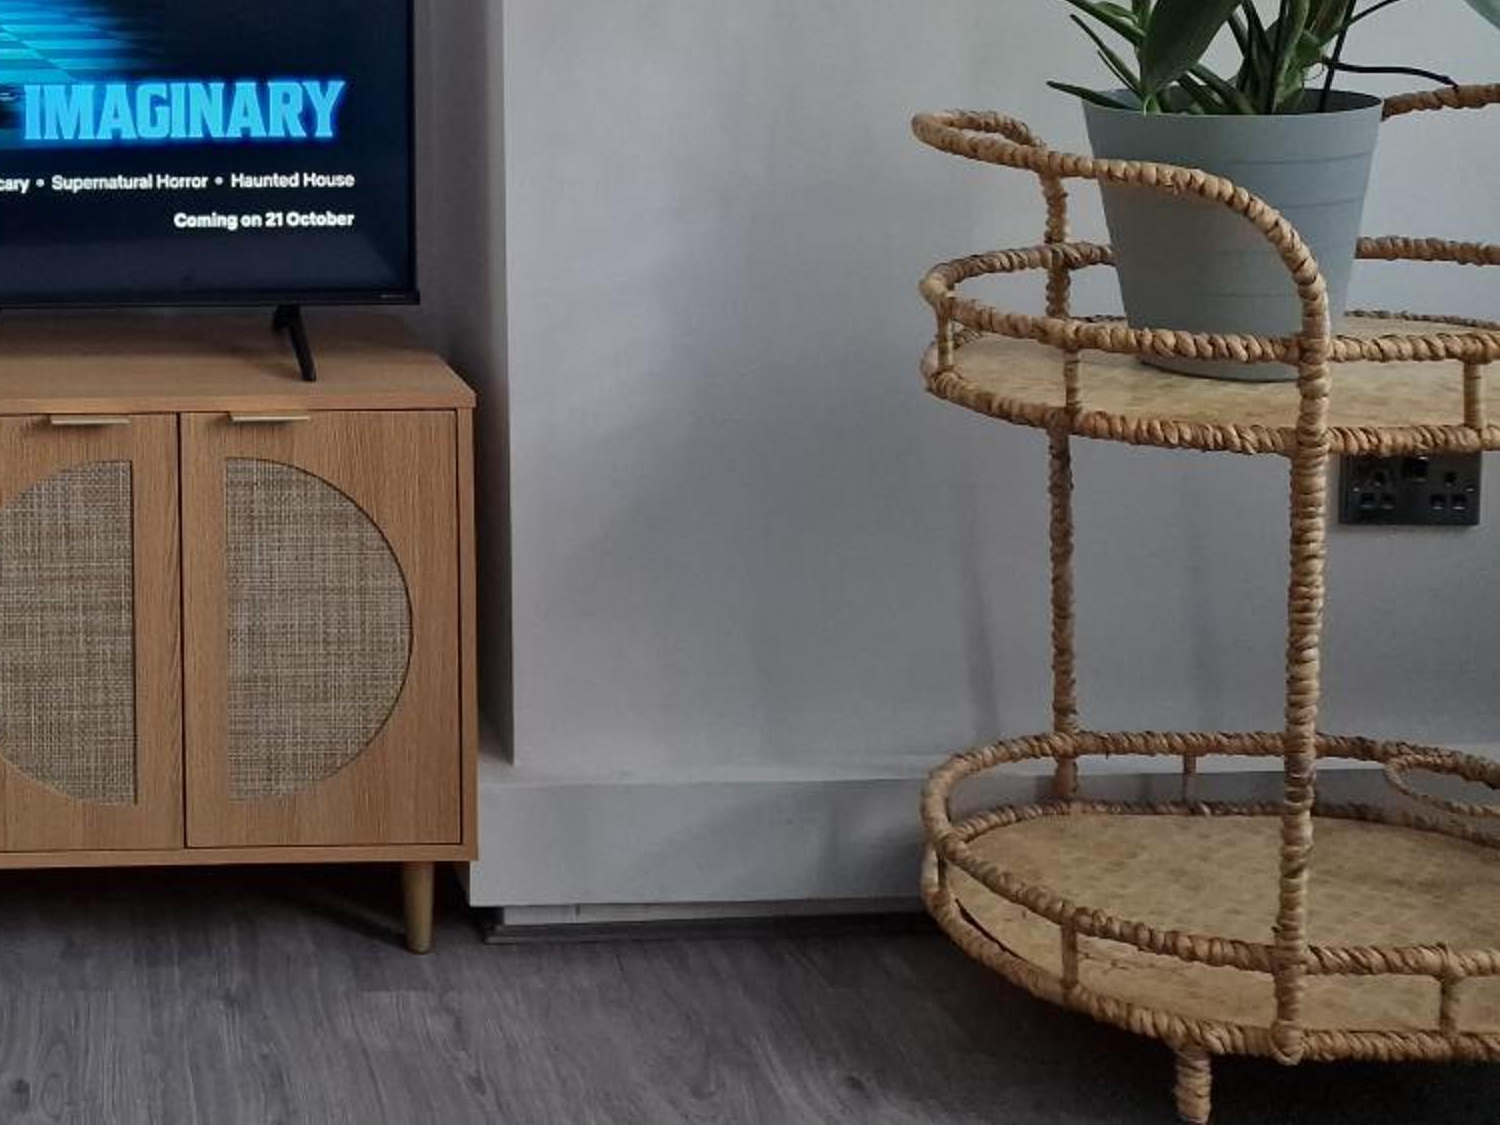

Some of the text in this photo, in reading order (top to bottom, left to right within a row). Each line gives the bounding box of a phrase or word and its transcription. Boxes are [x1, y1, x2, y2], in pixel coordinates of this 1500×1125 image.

[23, 81, 346, 140] IMAGINARY
[51, 173, 153, 193] Supernatural
[156, 173, 208, 189] Horror
[231, 172, 300, 188] Haunted
[303, 172, 356, 187] House
[173, 210, 356, 231] Coming on 21 October
